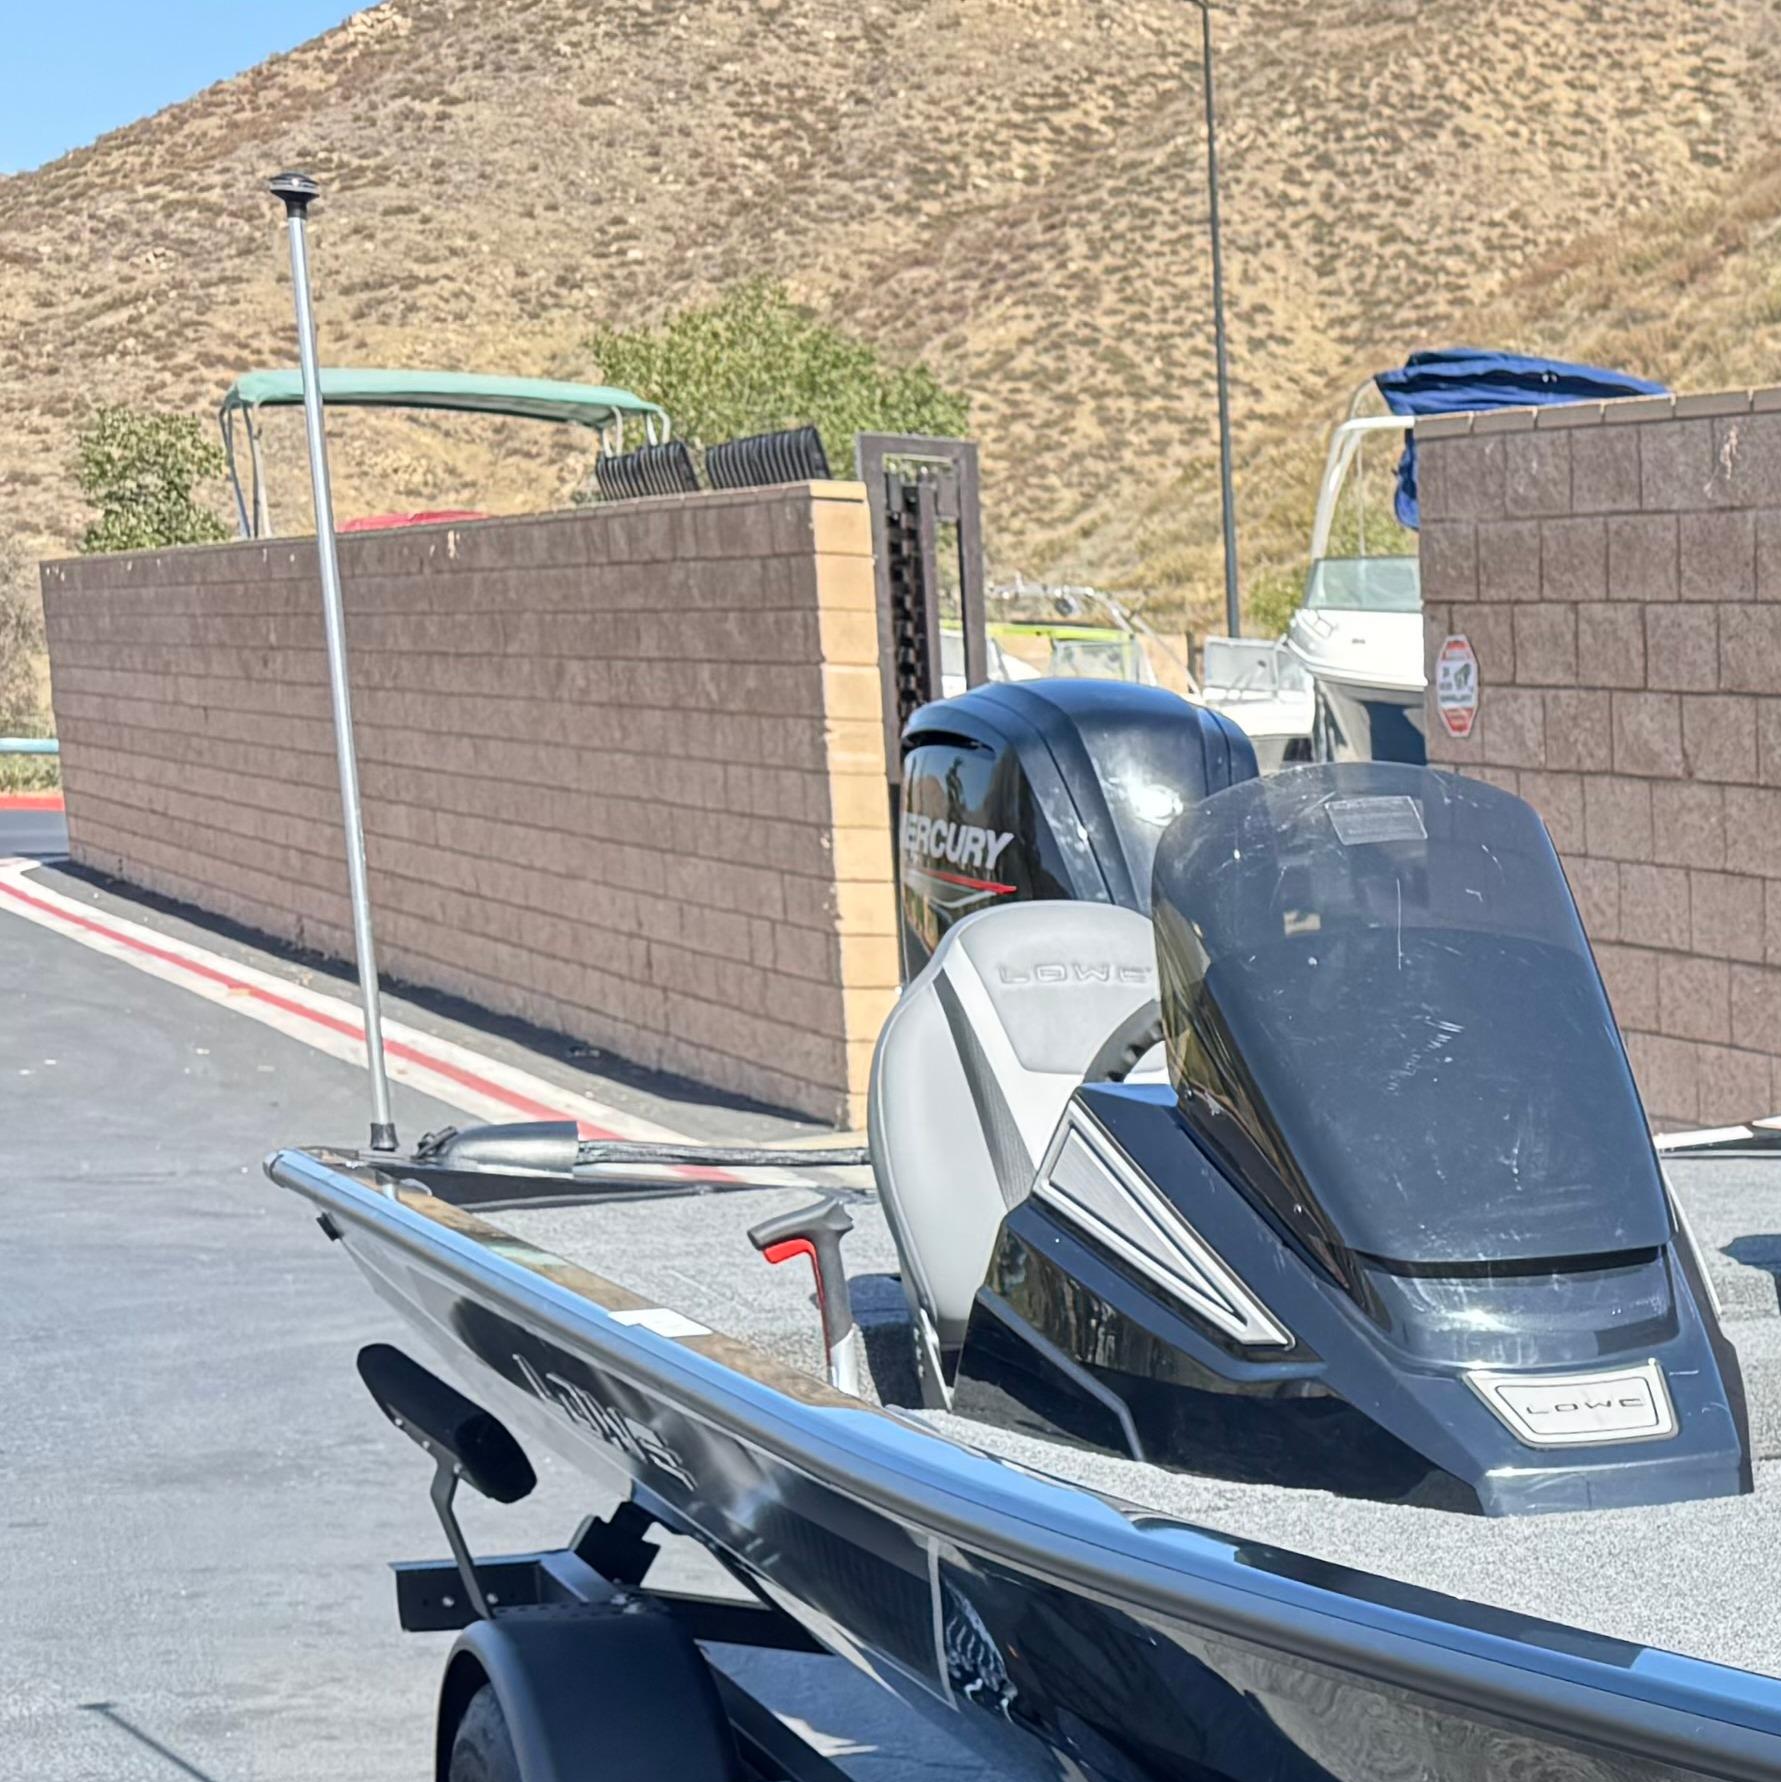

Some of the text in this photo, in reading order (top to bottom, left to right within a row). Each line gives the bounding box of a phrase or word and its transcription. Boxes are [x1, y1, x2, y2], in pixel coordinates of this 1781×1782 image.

[904, 812, 1015, 871] ERCURY
[997, 961, 1153, 984] LOWE
[1526, 1398, 1645, 1415] LOWE
